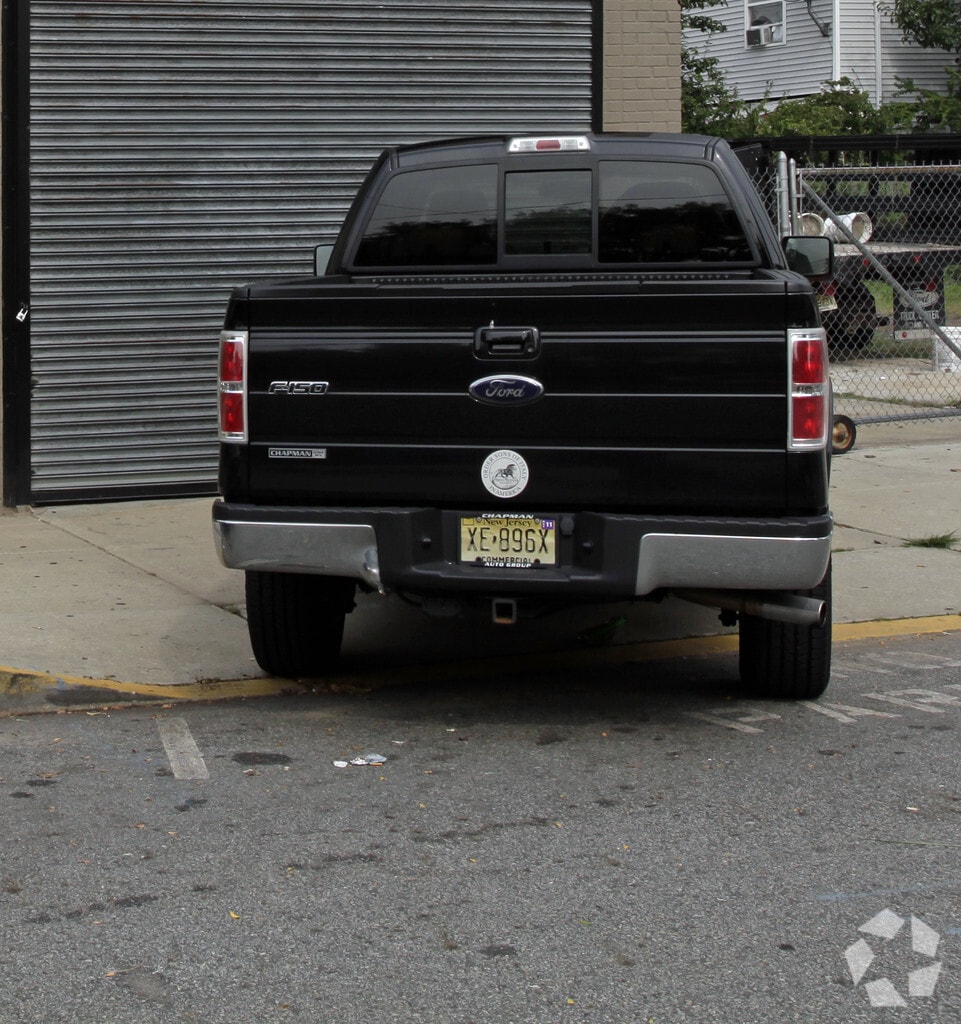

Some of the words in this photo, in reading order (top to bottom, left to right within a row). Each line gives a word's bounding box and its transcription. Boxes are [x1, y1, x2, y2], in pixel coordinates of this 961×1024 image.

[268, 381, 329, 395] F-150
[485, 379, 526, 398] Ford
[483, 517, 503, 526] New
[503, 517, 533, 528] Jersey
[481, 556, 532, 564] COMMERCIAL
